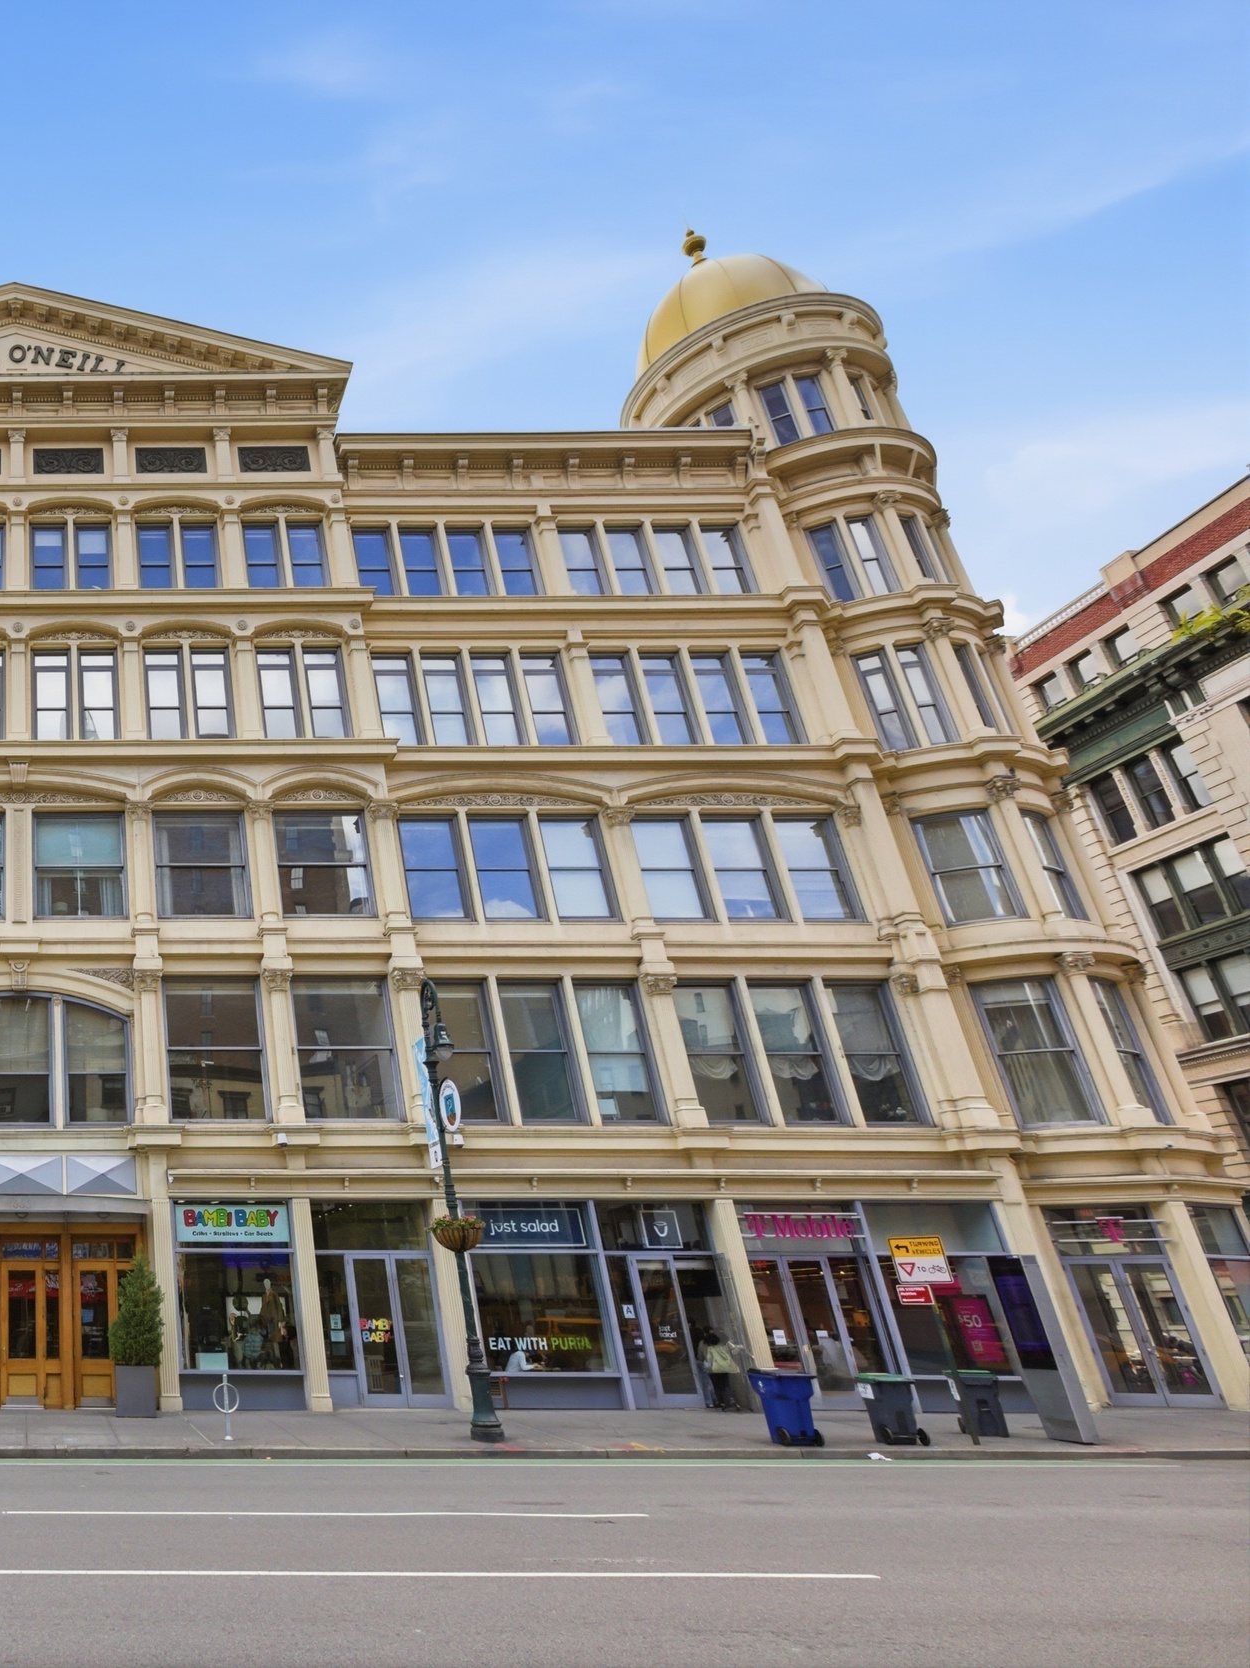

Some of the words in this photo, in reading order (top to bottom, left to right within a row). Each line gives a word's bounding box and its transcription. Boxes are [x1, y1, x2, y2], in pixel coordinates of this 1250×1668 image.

[8, 344, 126, 373] O'NEILL
[183, 1208, 232, 1228] BAMBI
[234, 1209, 279, 1228] BABY
[490, 1219, 518, 1236] just
[520, 1219, 559, 1232] salad
[626, 1306, 632, 1315] A
[359, 1318, 392, 1331] BAMBI
[362, 1330, 391, 1343] BABY
[488, 1336, 511, 1350] EAT
[514, 1337, 548, 1351] WITH
